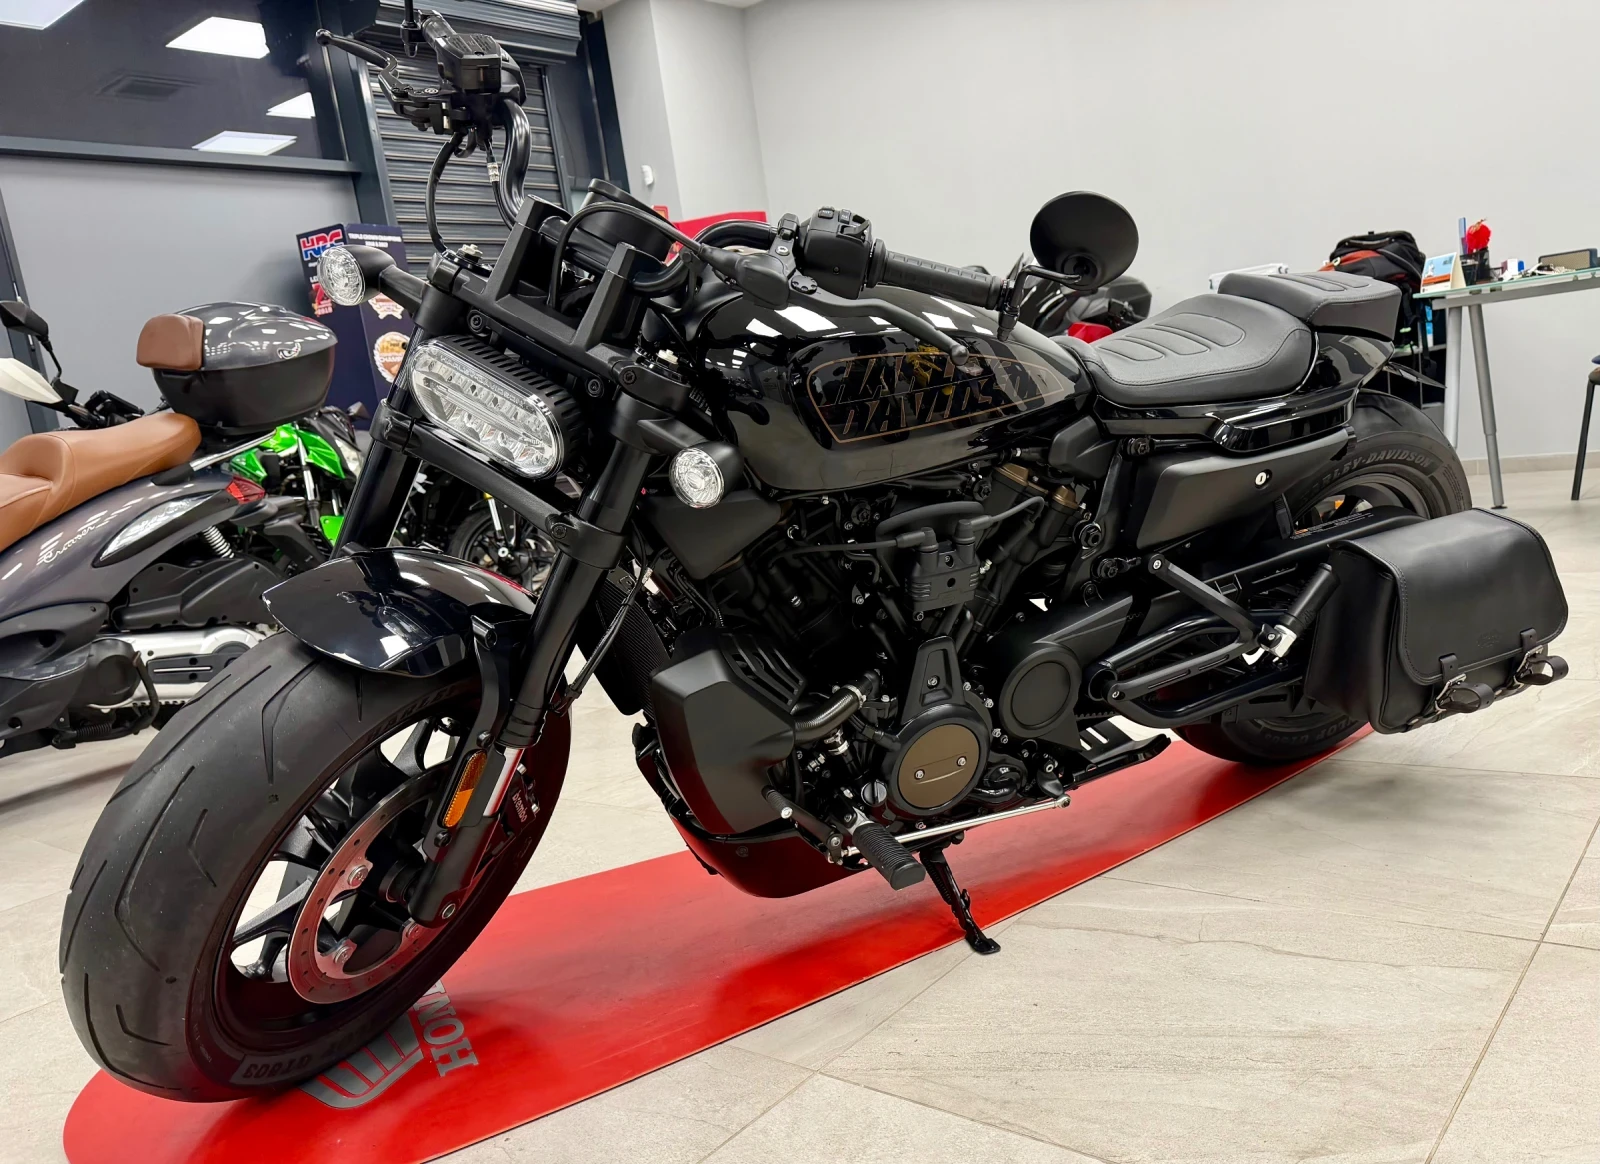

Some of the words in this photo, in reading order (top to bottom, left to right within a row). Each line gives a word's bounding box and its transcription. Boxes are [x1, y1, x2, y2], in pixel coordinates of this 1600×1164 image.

[300, 229, 345, 261] HRC
[511, 790, 528, 822] brembo
[412, 980, 479, 1077] HON
